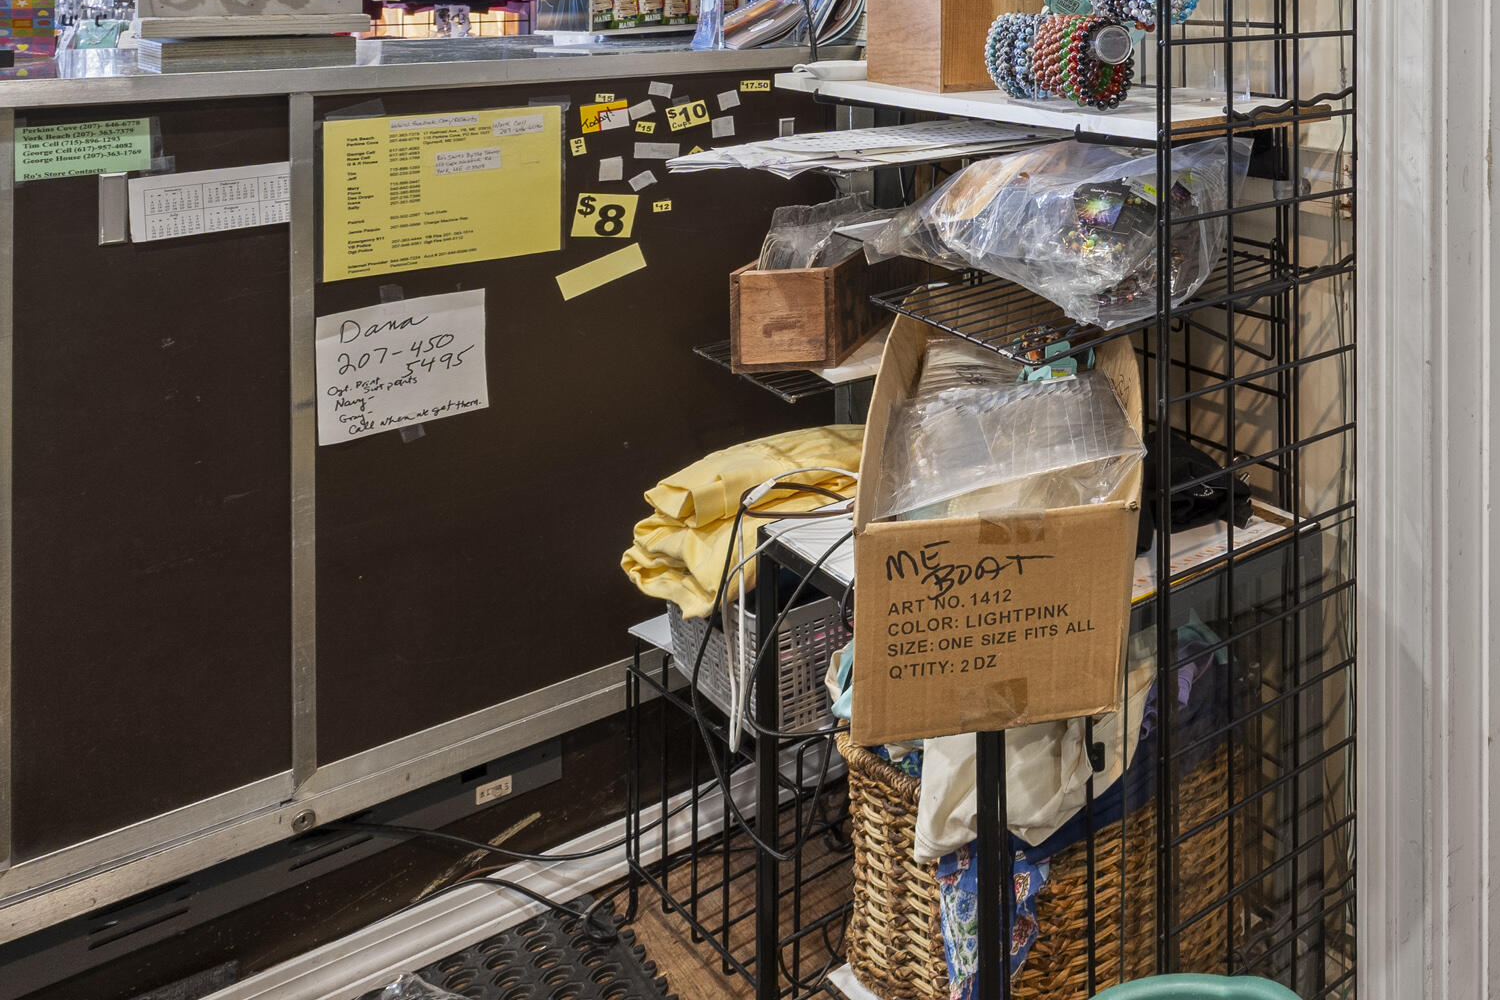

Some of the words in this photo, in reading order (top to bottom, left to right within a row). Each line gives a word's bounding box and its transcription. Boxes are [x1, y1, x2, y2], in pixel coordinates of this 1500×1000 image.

[741, 81, 769, 90] $17.50
[579, 106, 616, 129] Today!
[667, 102, 707, 123] $10
[22, 127, 54, 135] Perkins
[56, 125, 77, 133] Cove
[23, 134, 44, 142] York
[22, 149, 54, 158] George
[55, 147, 72, 155] Cell
[23, 142, 40, 150] Tim
[42, 140, 59, 148] Cell
[22, 157, 54, 165] George
[23, 172, 42, 180] Ro's
[44, 170, 65, 178] Store
[577, 195, 626, 236] $8
[654, 203, 670, 211] $12
[340, 315, 429, 344] Dana
[337, 333, 455, 375] 207-450
[402, 344, 475, 378] 5495
[348, 422, 375, 435] Call
[380, 413, 416, 426] when
[431, 401, 455, 417] get
[885, 540, 951, 581] ME
[921, 555, 1055, 601] BOAT
[887, 598, 926, 616] ART
[933, 595, 965, 611] NO.
[970, 588, 1013, 607] 1412
[887, 616, 959, 637] COLOR:
[966, 603, 1070, 629] LIGHTPINK
[887, 640, 934, 658] SIZE:
[938, 636, 974, 651] ONE
[980, 630, 1017, 646] SIZE
[1024, 625, 1059, 641] FITS
[1065, 619, 1096, 635] ALL
[889, 660, 954, 680] Q'TITY:
[960, 659, 969, 673] 2
[973, 655, 997, 670] DZ
